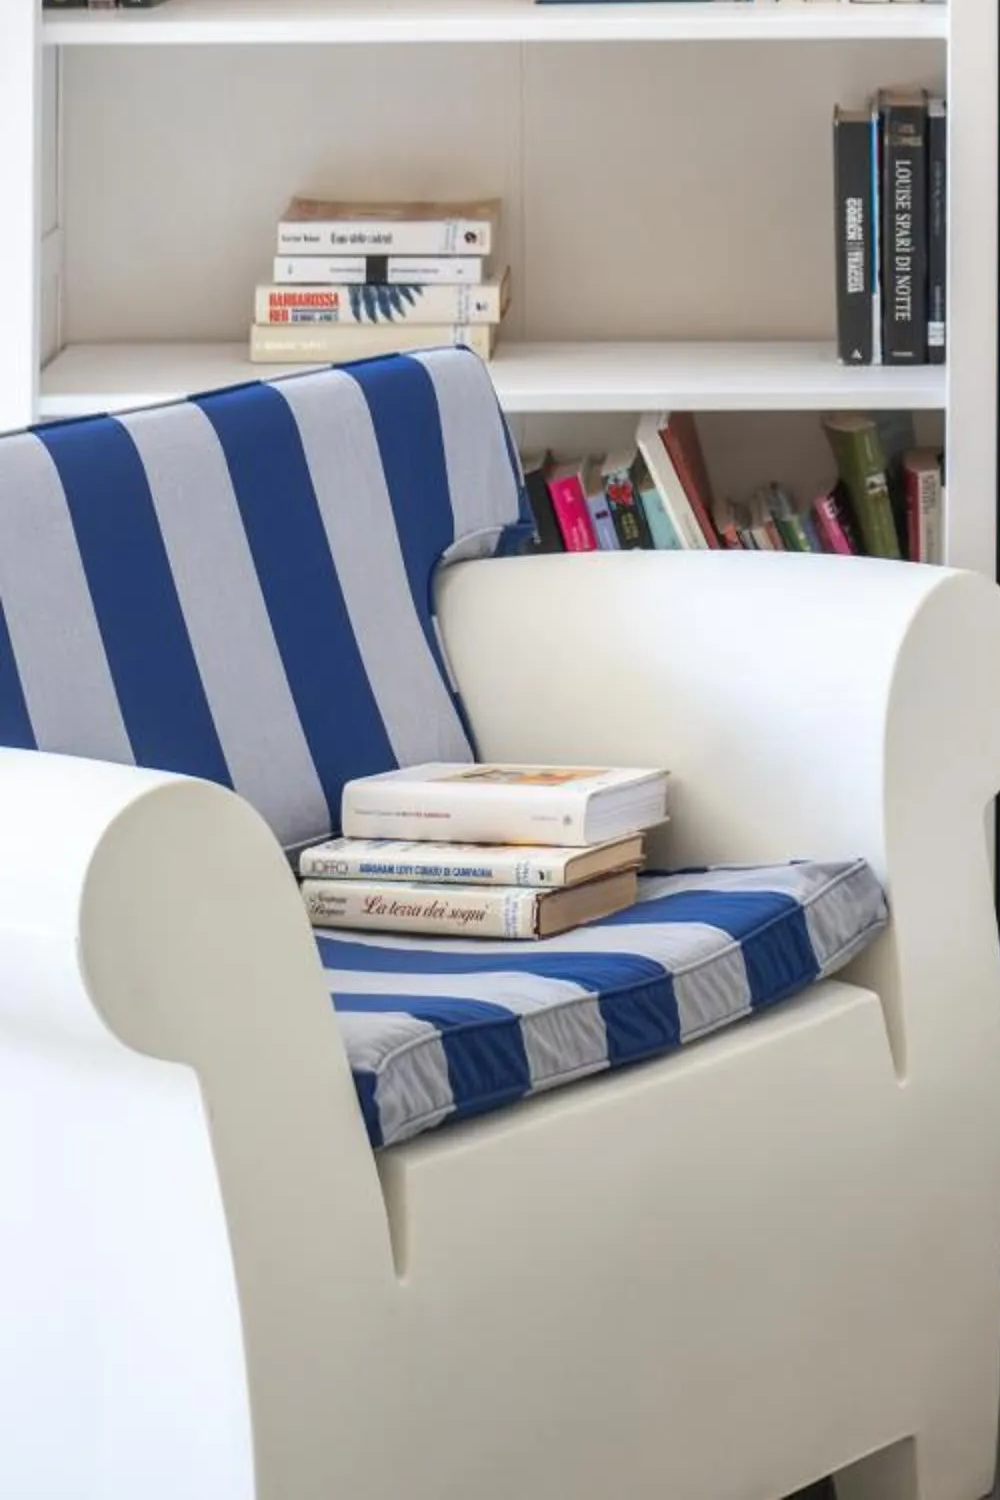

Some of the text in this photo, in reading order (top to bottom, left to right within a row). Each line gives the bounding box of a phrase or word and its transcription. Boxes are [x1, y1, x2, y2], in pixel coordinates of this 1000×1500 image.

[895, 159, 915, 322] LOUISE SPARÌ DI NOTTE
[363, 893, 387, 915] La
[387, 897, 423, 916] terra
[424, 899, 446, 919] dei
[448, 904, 488, 928] sogni
